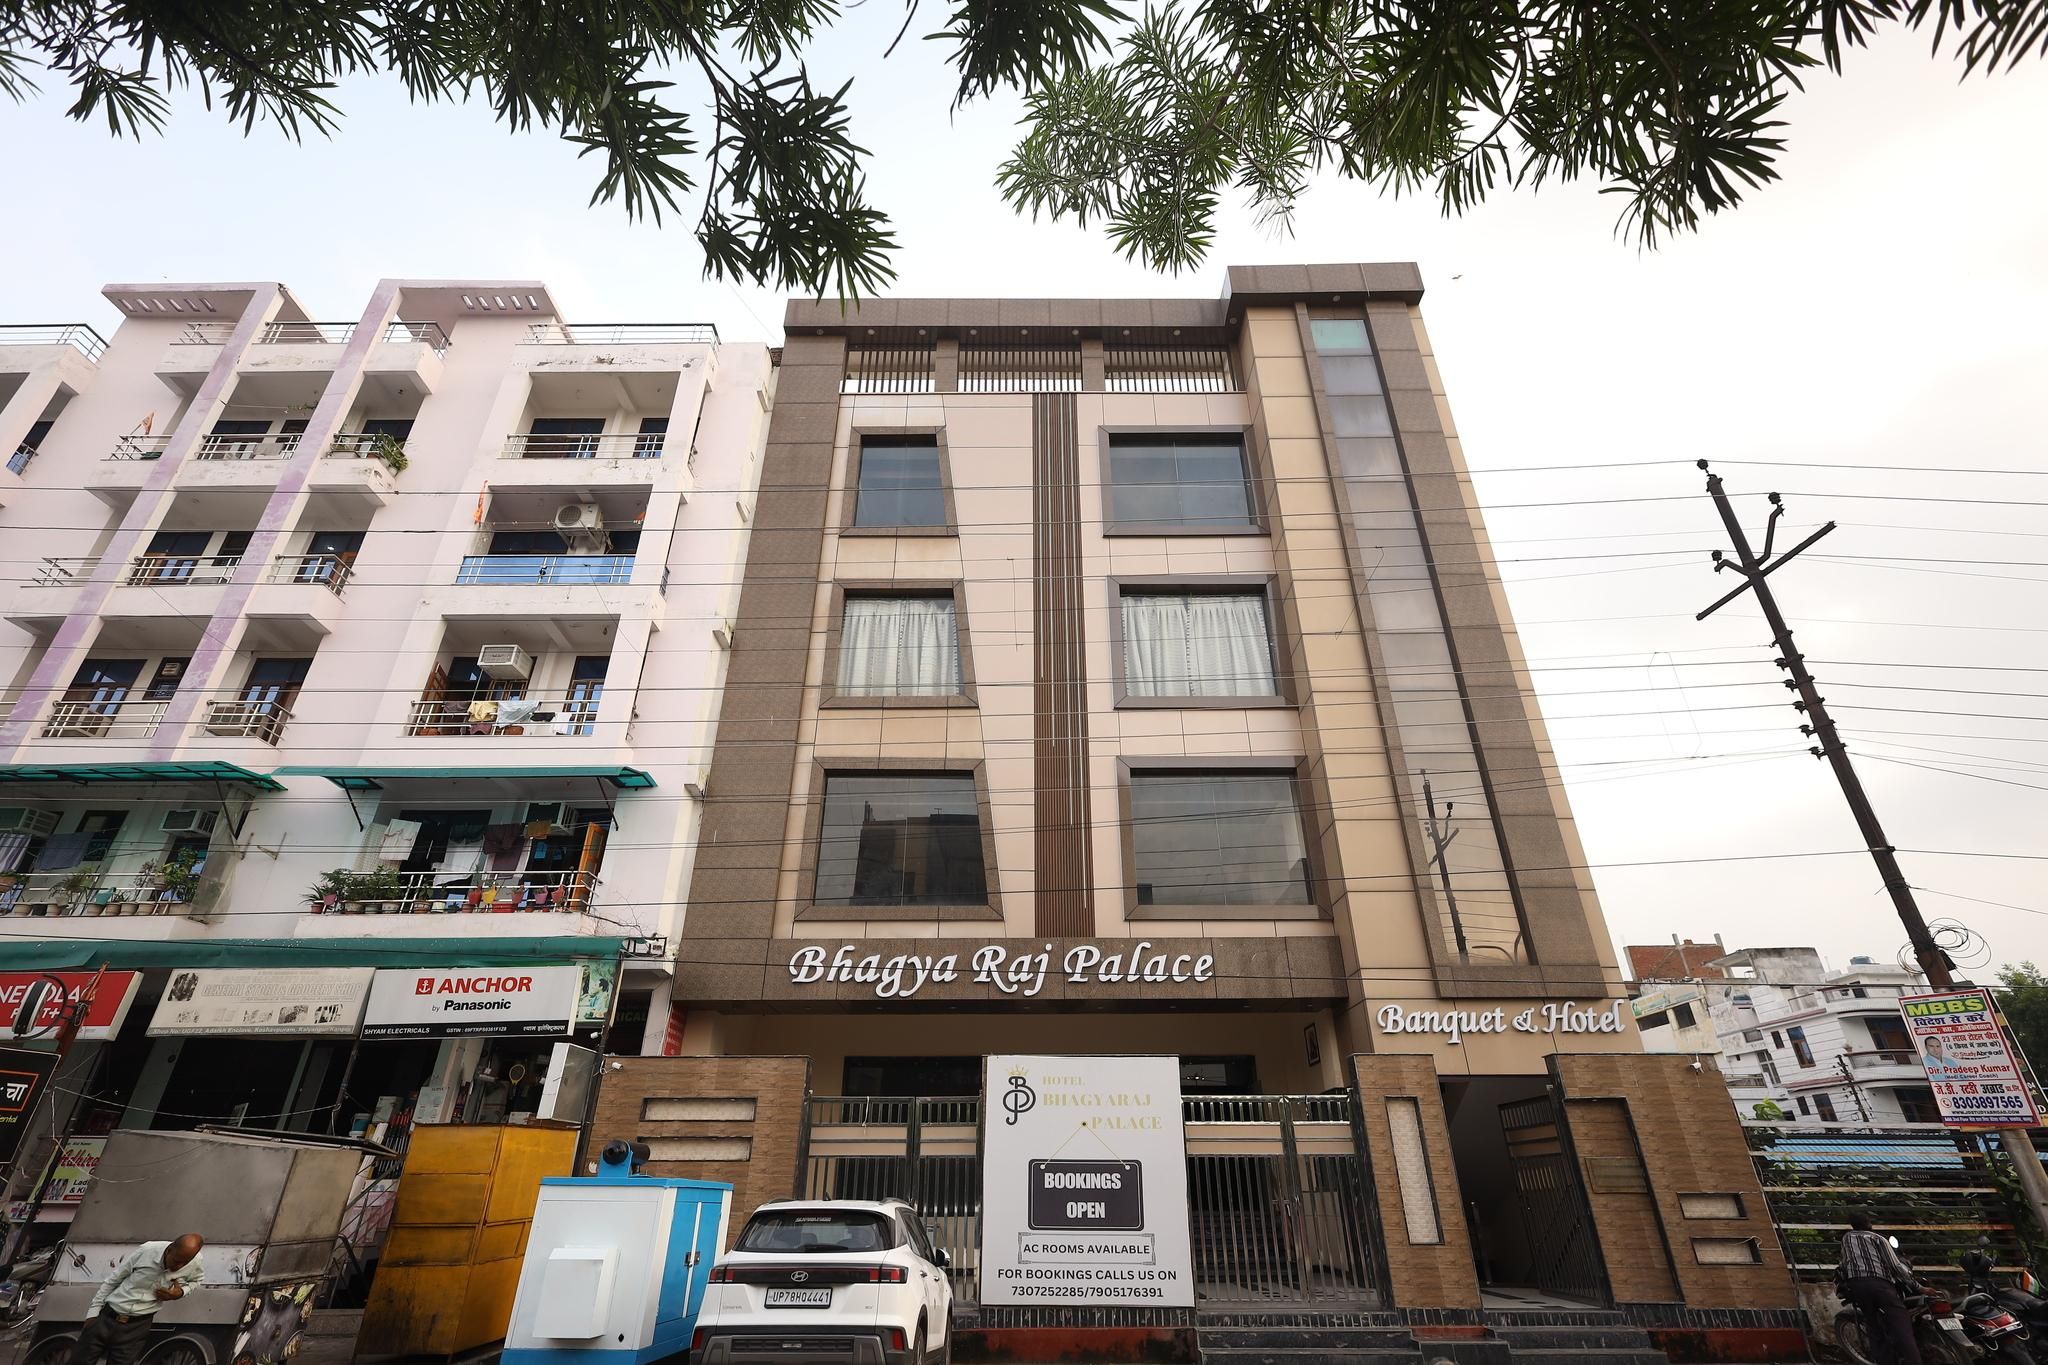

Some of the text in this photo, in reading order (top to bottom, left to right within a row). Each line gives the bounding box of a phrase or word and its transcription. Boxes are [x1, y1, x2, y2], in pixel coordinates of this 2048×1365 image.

[790, 941, 1213, 998] Bhagya Raj Palace
[437, 976, 533, 994] ANCHOR
[431, 998, 512, 1013] by Panasonic
[1906, 999, 1984, 1017] MBBS
[1377, 1003, 1507, 1044] Banquet
[1511, 1007, 1538, 1033] &
[1541, 999, 1626, 1033] Hotel
[387, 1027, 430, 1035] ELECTRICALS
[1928, 1064, 2010, 1076] Dir. Pradeep Kumar
[1042, 1075, 1085, 1086] HOTEL
[1043, 1093, 1151, 1107] BHAGYARAJ
[1953, 1096, 2024, 1109] 8303897565
[1092, 1116, 1162, 1130] PALACE
[1044, 1172, 1122, 1190] BOOKINGS
[1066, 1201, 1106, 1219] OPEN
[1023, 1244, 1150, 1255] AC ROOMS AVAILABLE
[998, 1269, 1177, 1281] FOR BOOKINGS CALLS US ON
[1011, 1285, 1164, 1298] 7307252285/7905176391
